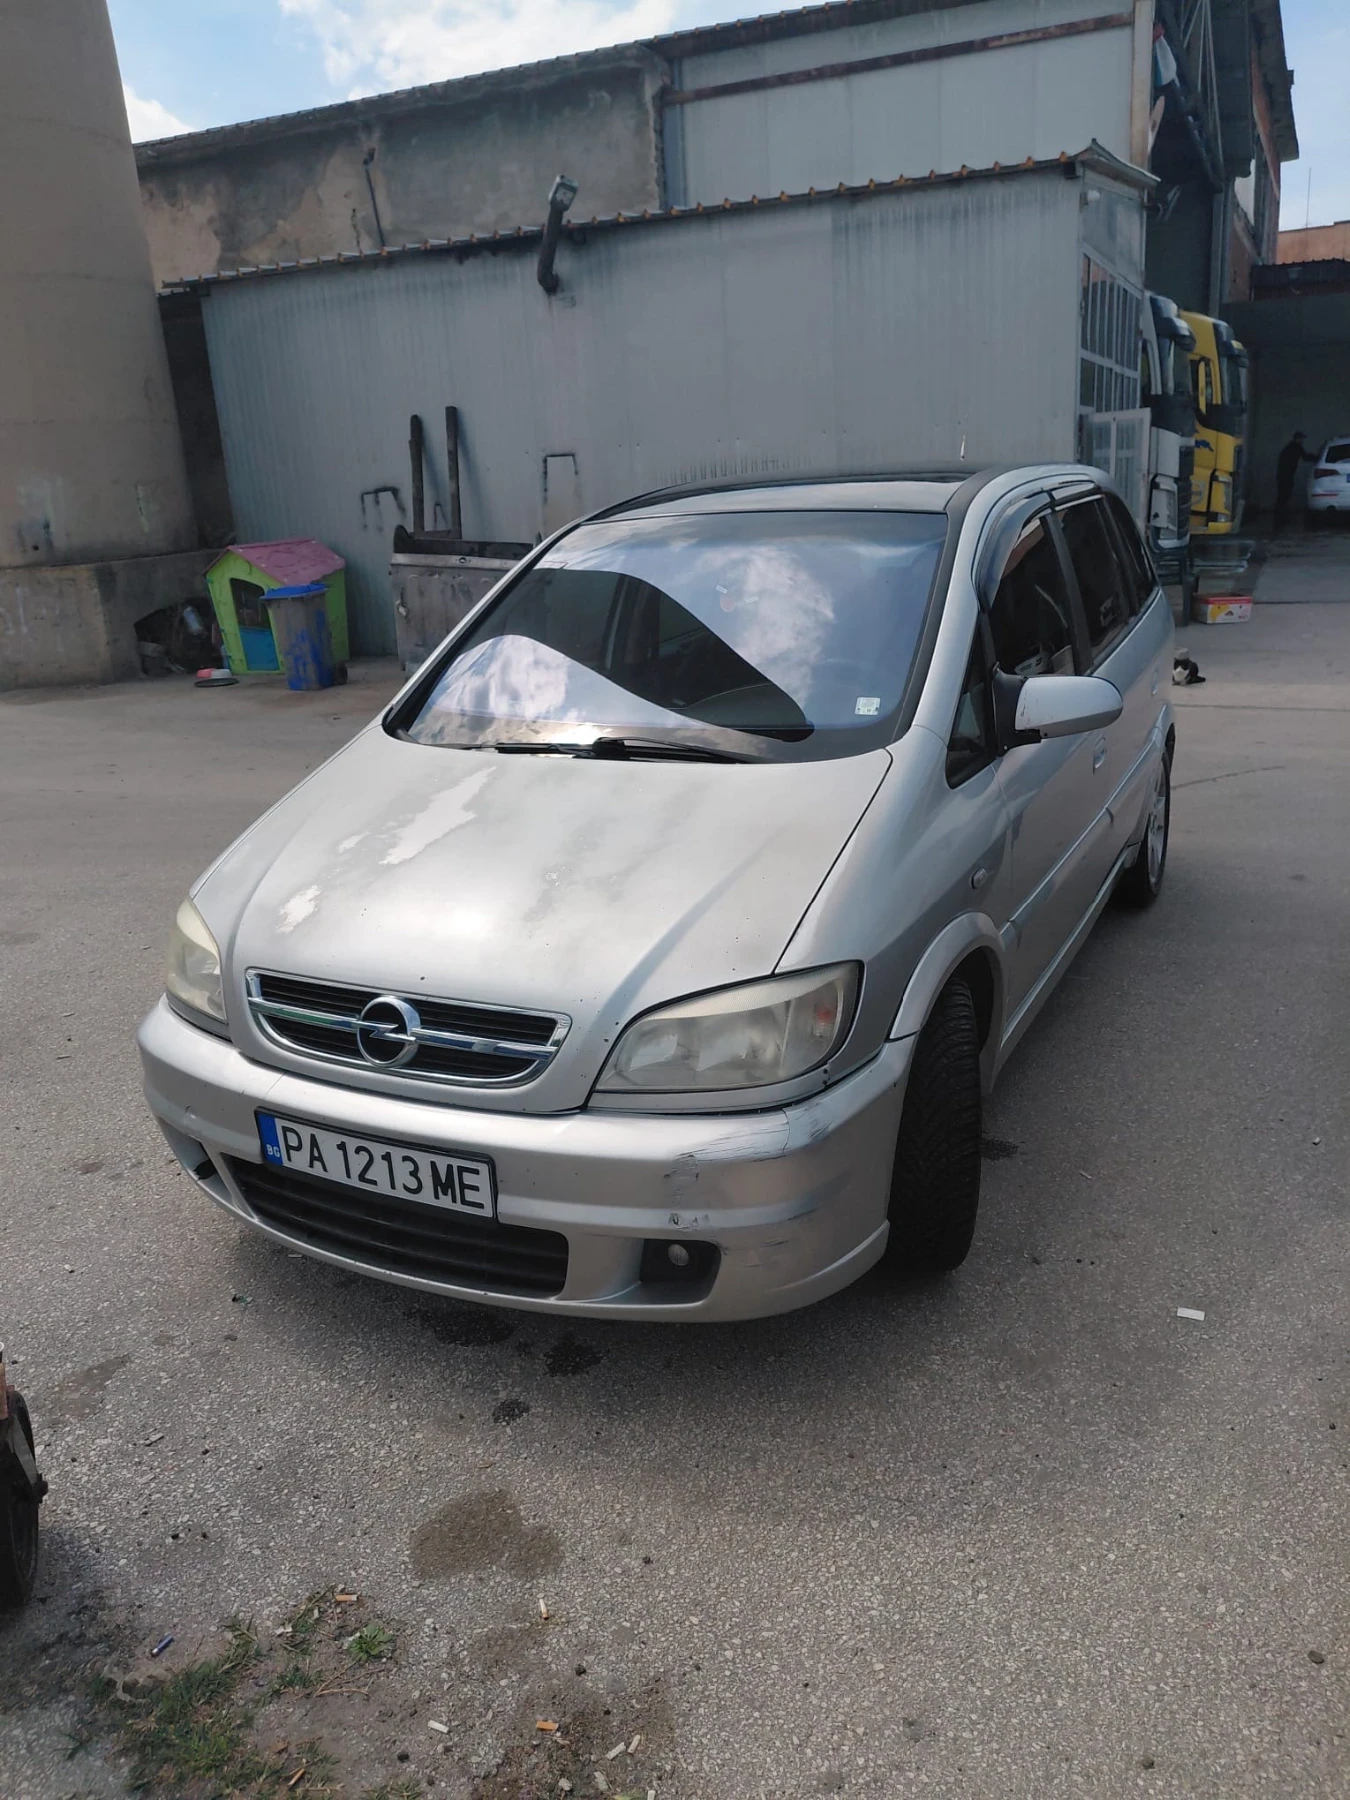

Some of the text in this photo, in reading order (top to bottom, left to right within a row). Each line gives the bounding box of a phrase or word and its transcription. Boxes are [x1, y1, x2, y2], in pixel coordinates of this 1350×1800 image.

[266, 1145, 281, 1158] BG
[281, 1125, 485, 1210] PA 1213 ME
